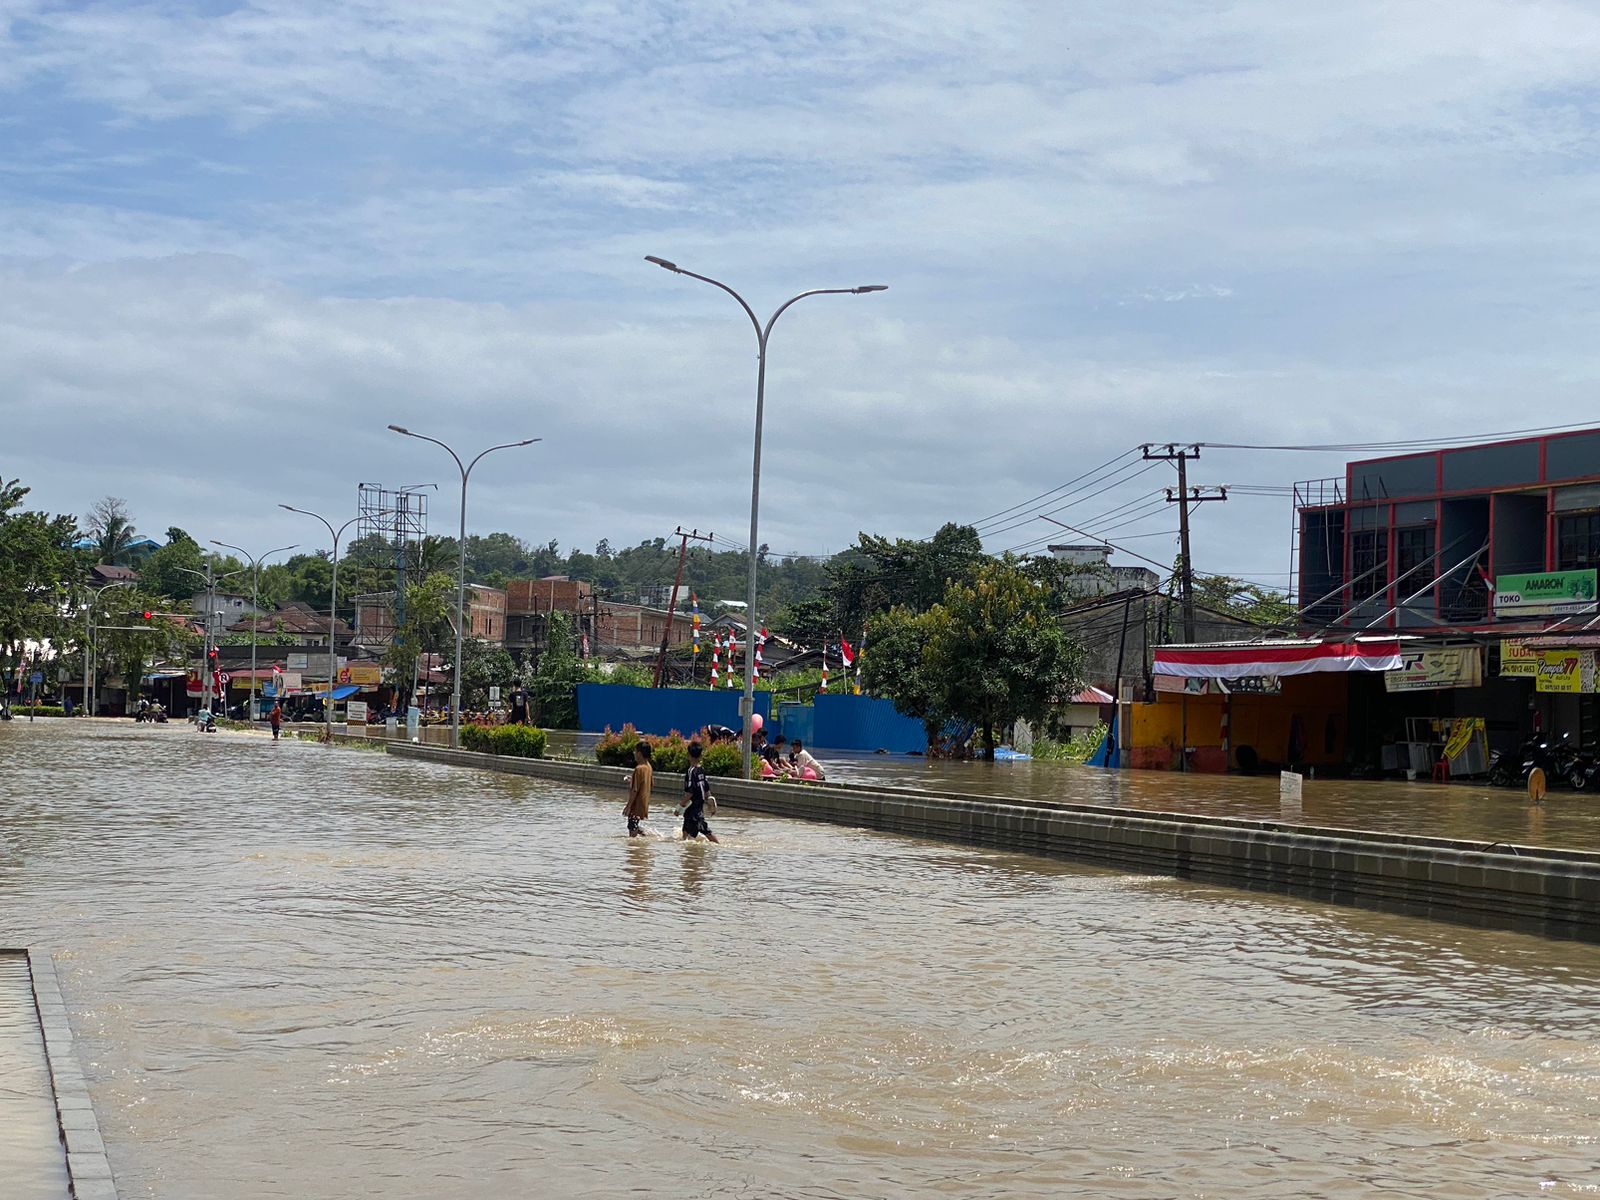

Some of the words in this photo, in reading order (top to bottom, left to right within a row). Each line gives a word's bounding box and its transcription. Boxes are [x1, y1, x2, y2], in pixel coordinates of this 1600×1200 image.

[1525, 578, 1564, 591] AMARON
[1499, 595, 1520, 603] TOKO
[1563, 658, 1578, 675] 77
